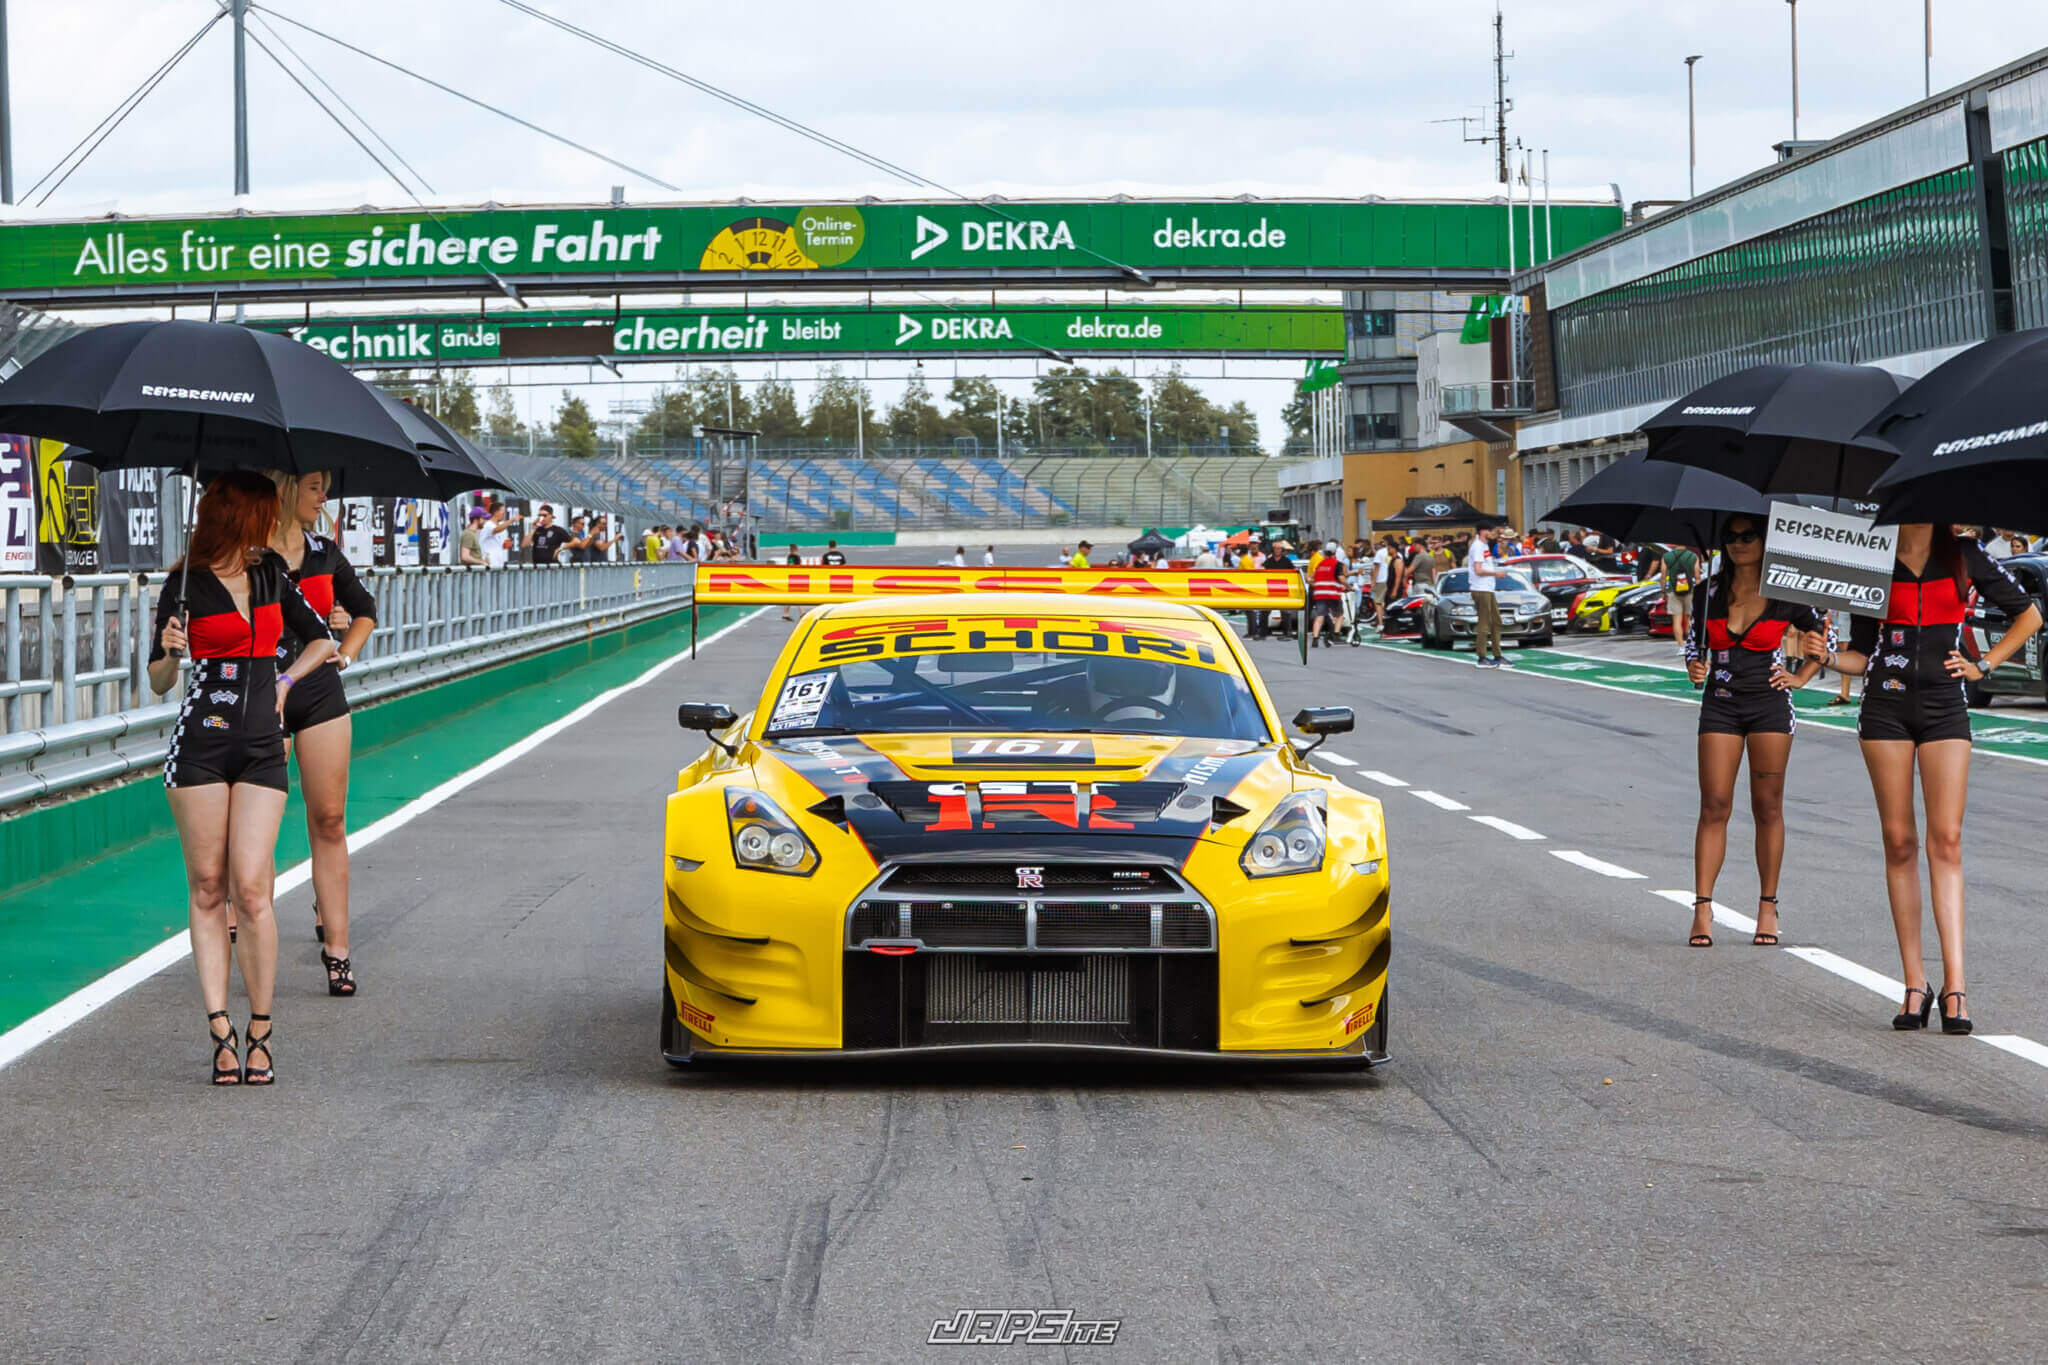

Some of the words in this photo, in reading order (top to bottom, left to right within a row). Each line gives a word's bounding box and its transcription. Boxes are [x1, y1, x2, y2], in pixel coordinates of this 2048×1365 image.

[802, 216, 857, 234] Online-
[962, 221, 1075, 251] DEKRA
[1153, 217, 1286, 249] dekra.de
[74, 234, 167, 275] Alles
[181, 229, 234, 271] für
[249, 233, 330, 269] eine
[345, 224, 518, 267] sichere
[531, 220, 662, 263] Fahrt
[753, 231, 767, 246] 12
[771, 235, 786, 252] 11
[784, 249, 802, 267] 10
[805, 232, 854, 246] Termin
[782, 318, 842, 341] bleibt
[932, 317, 1013, 340] DEKRA
[1066, 316, 1162, 339] dekra.de
[141, 385, 255, 403] REISBRENNEN
[1775, 518, 1892, 551] REISBRENNEN
[709, 571, 1291, 597] NISSAN
[822, 617, 1211, 645] GTR
[819, 630, 1216, 663] SCHORI
[786, 681, 828, 699] 161
[966, 738, 1082, 756] 161
[680, 1001, 716, 1034] PIRELLI
[1345, 1003, 1374, 1035] PIRELLI
